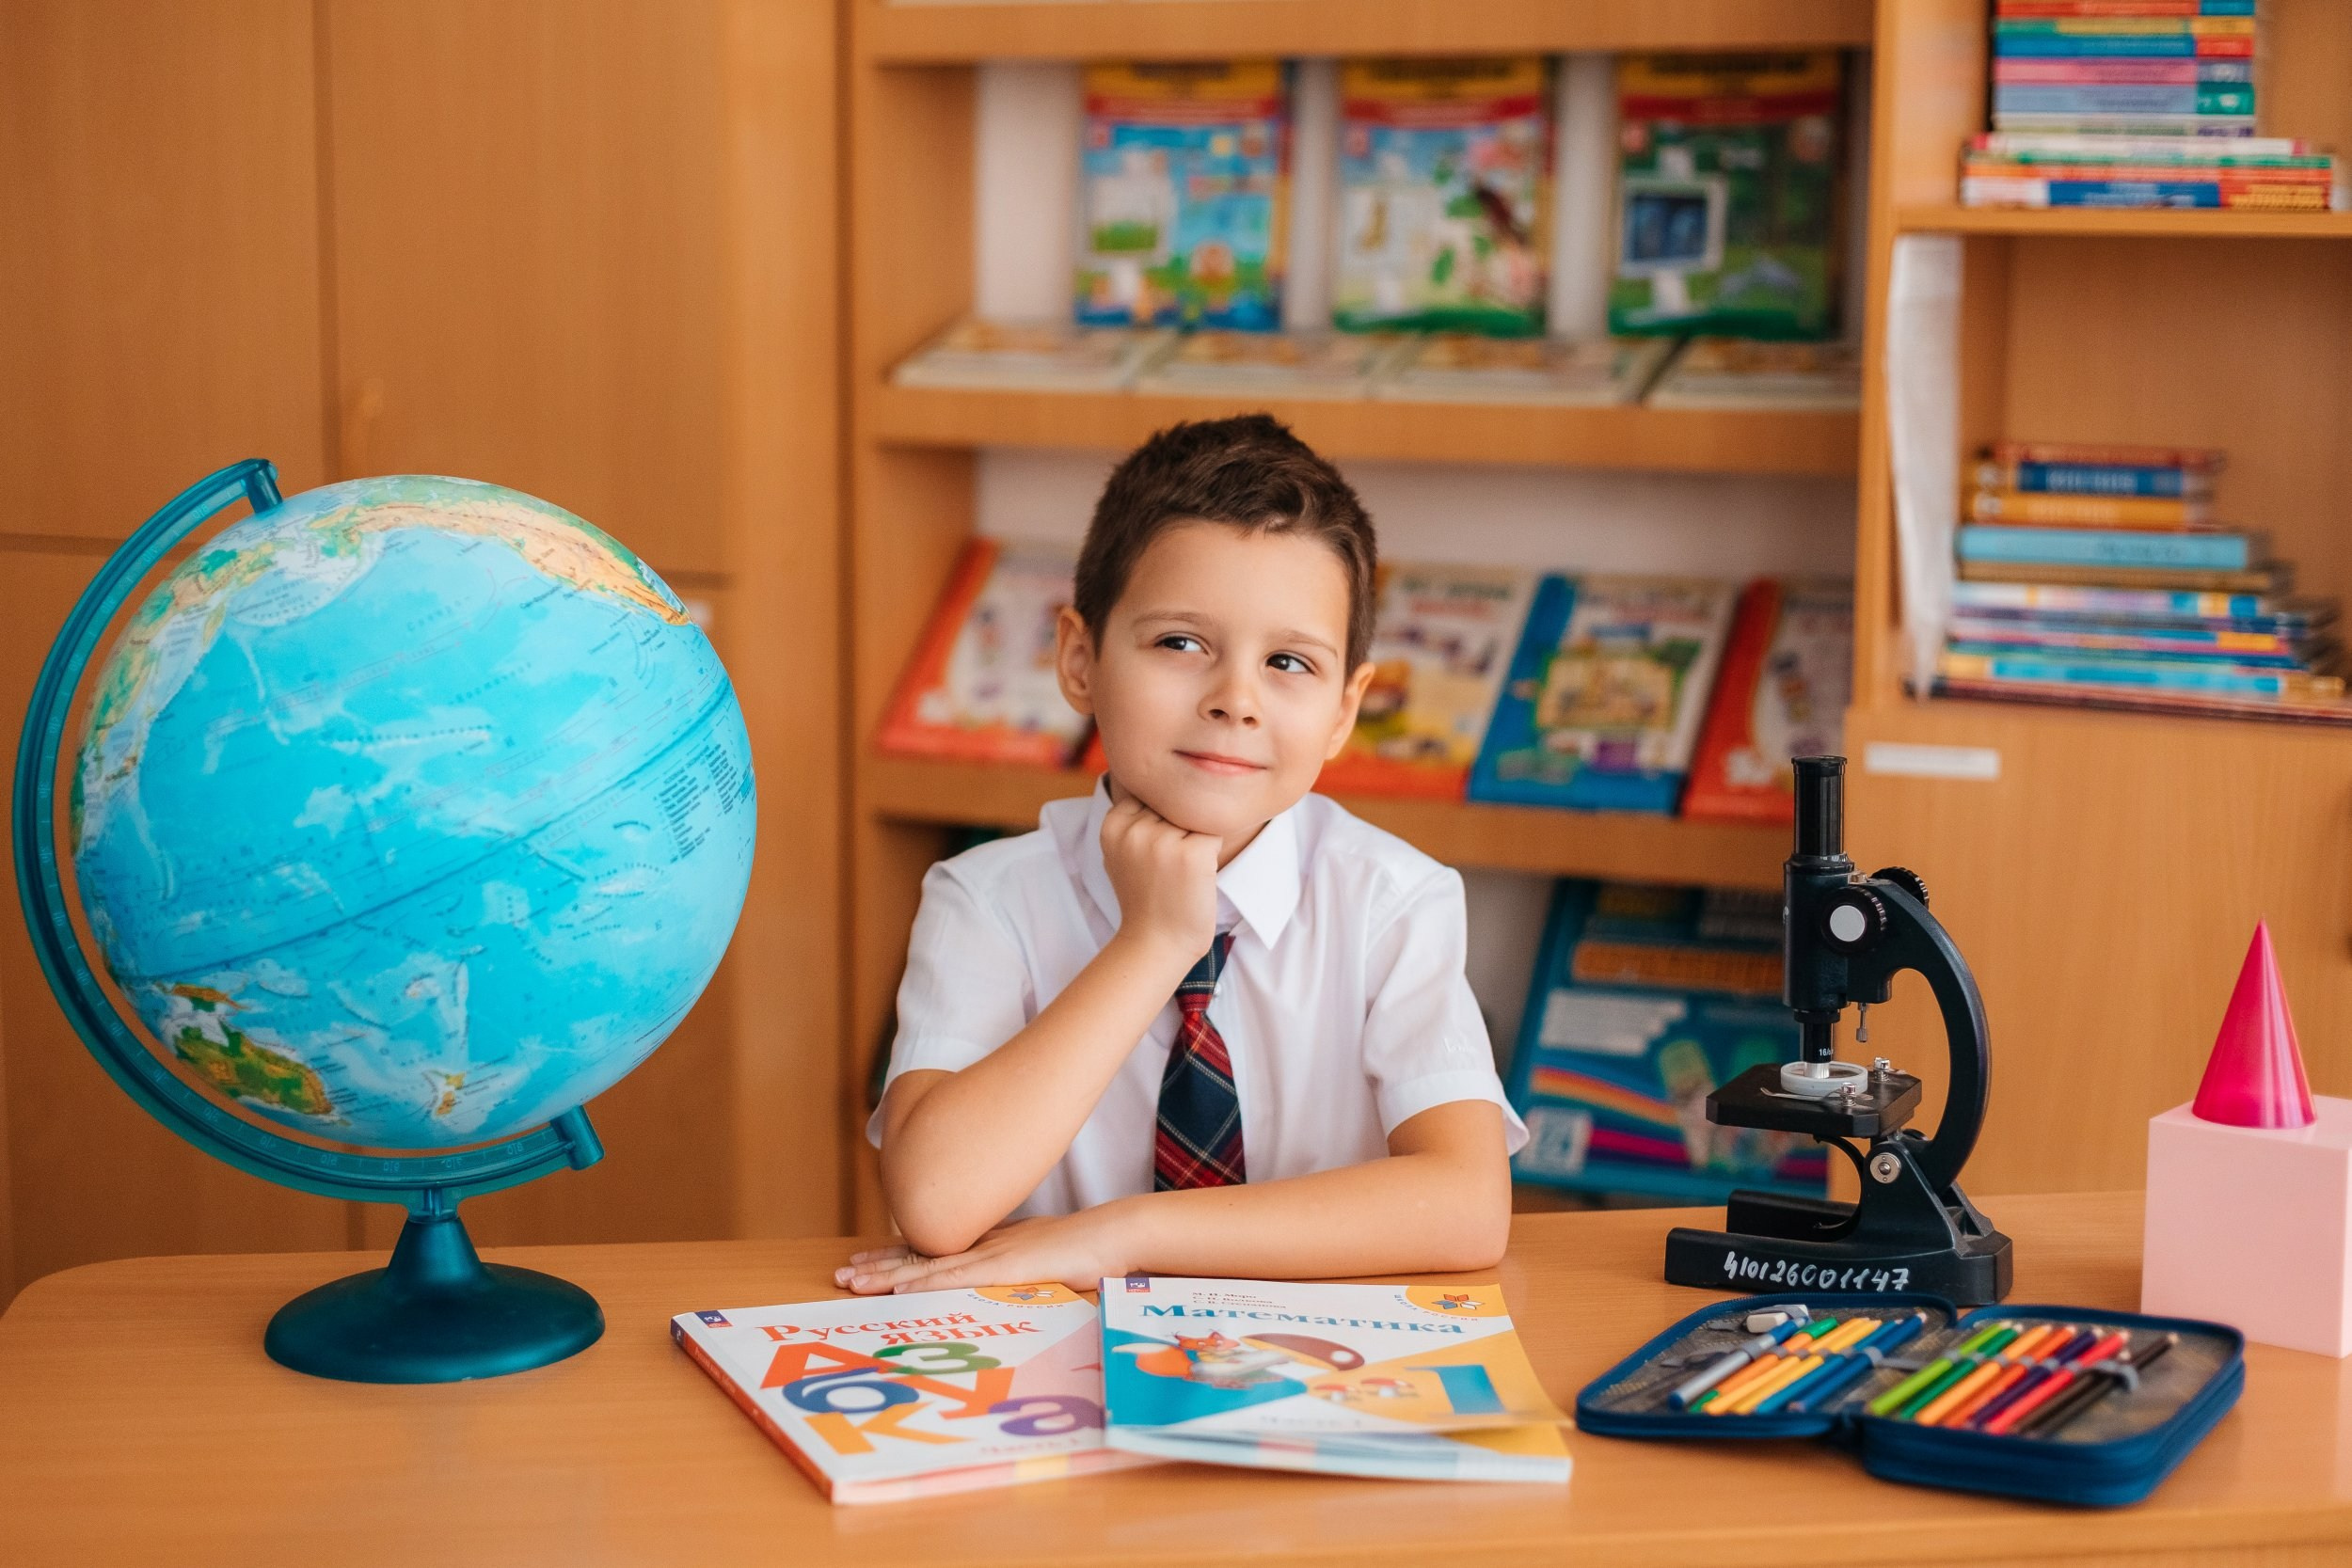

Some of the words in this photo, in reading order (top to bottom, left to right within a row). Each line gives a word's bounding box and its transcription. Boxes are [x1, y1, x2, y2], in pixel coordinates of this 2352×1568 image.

[1724, 1251, 1909, 1291] 410126001147
[755, 1312, 982, 1342] Русский
[880, 1321, 1045, 1345] язык
[1139, 1305, 1465, 1334] Математика
[1407, 1364, 1504, 1415] 1
